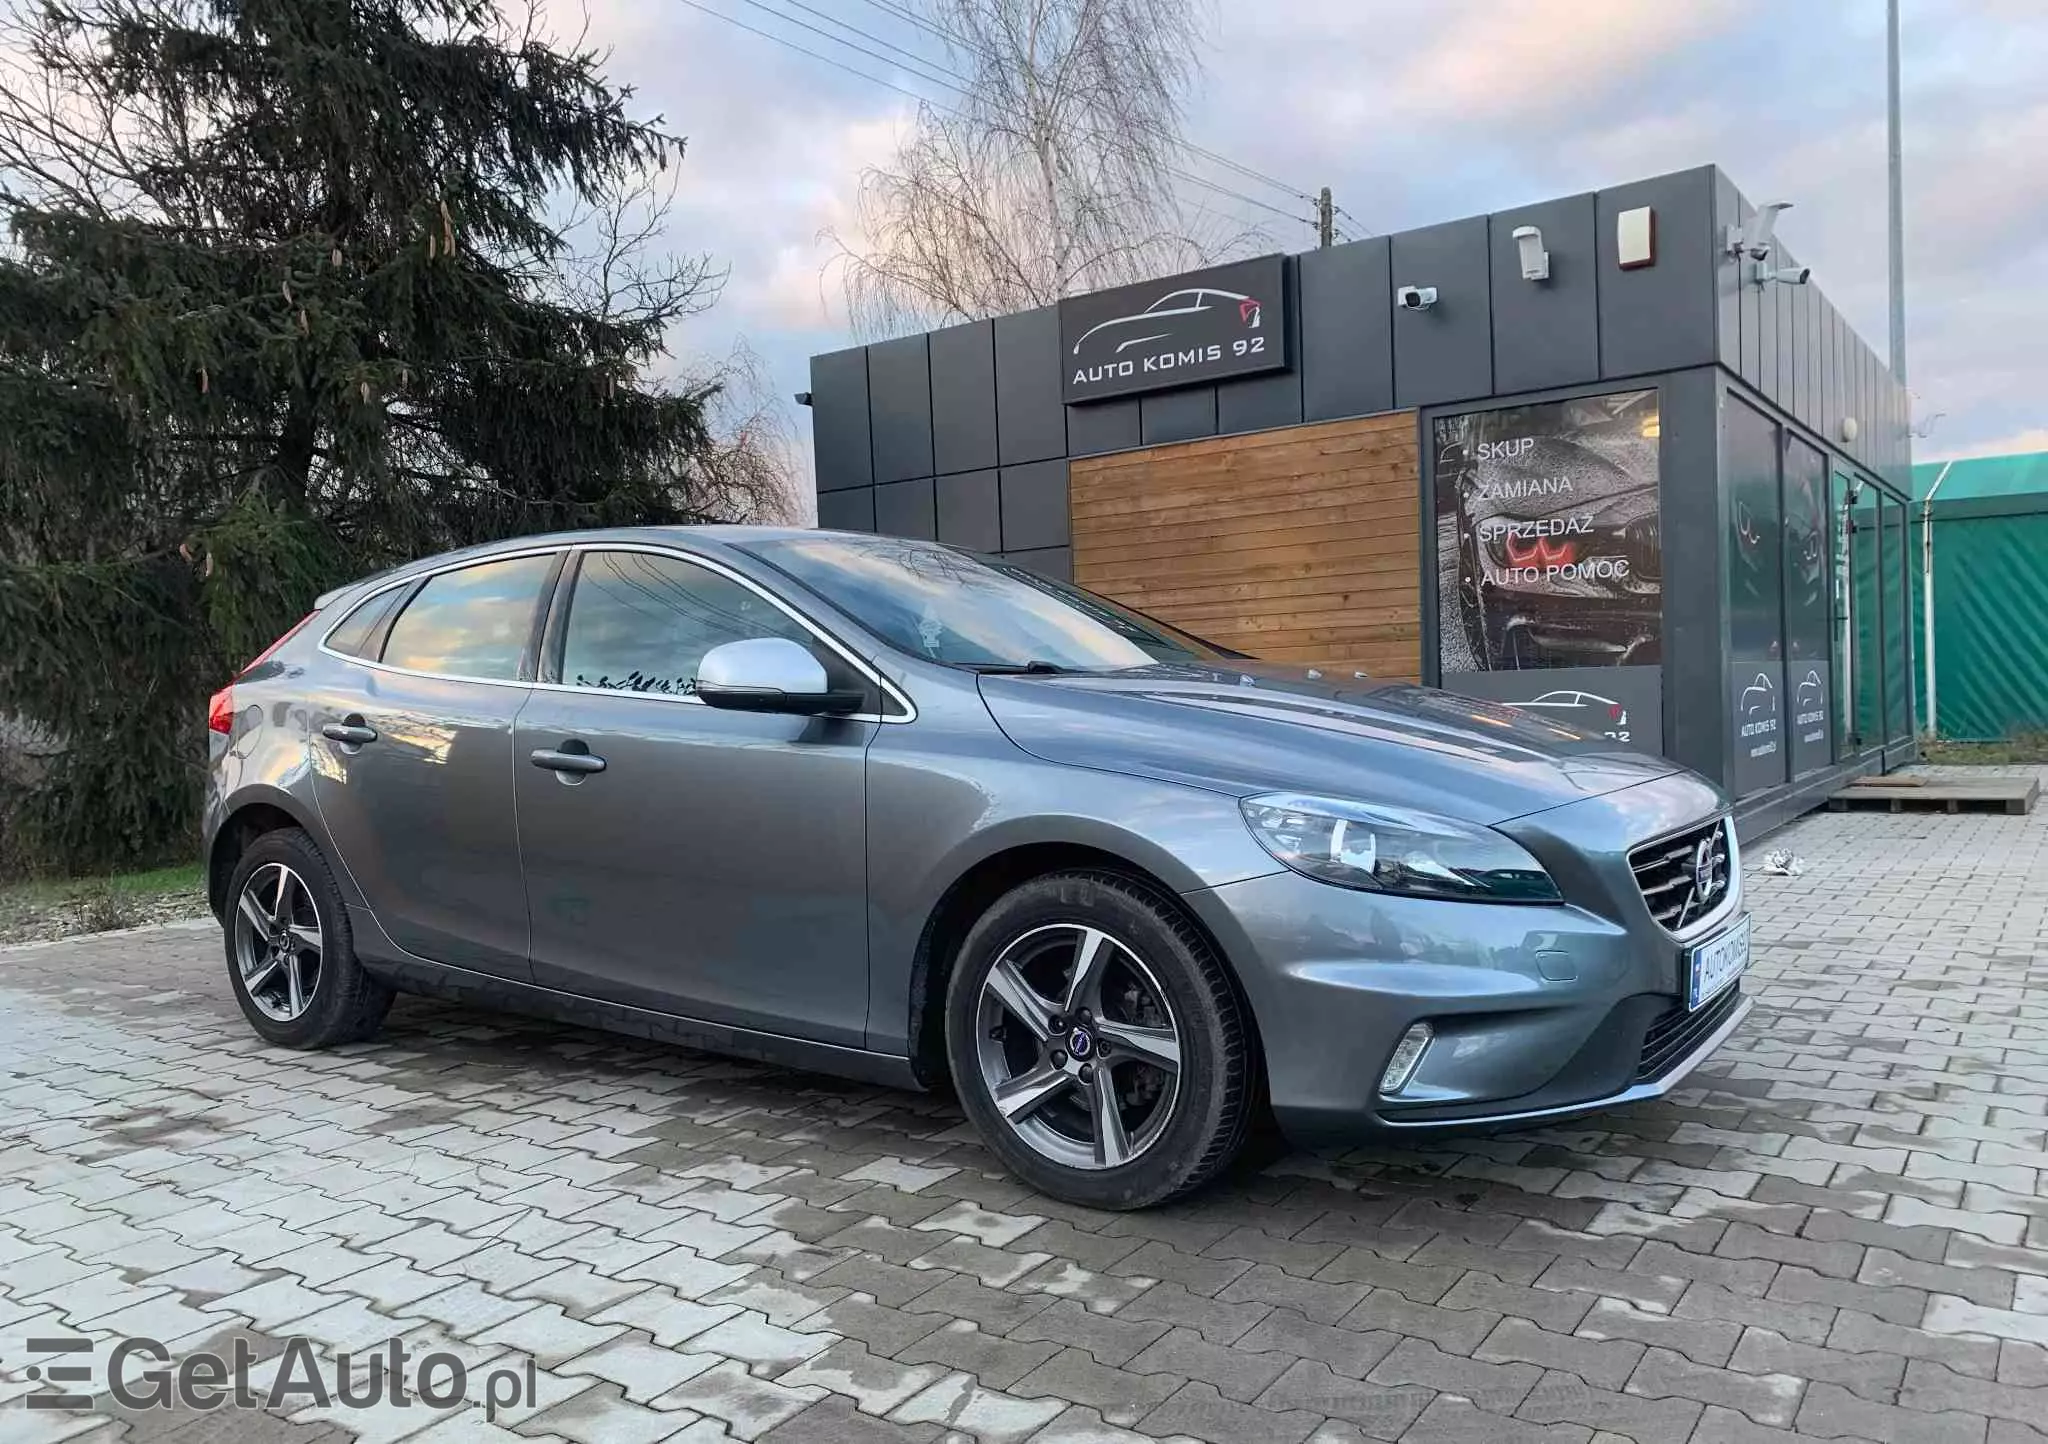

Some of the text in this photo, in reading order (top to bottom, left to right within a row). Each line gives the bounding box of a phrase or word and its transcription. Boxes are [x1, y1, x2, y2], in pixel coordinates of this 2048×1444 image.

[1072, 336, 1266, 385] AUTO KOMIS 92
[1477, 438, 1535, 461] SKUP
[1478, 475, 1574, 501] ZAMIANA
[1480, 559, 1630, 587] AUTO POMOC
